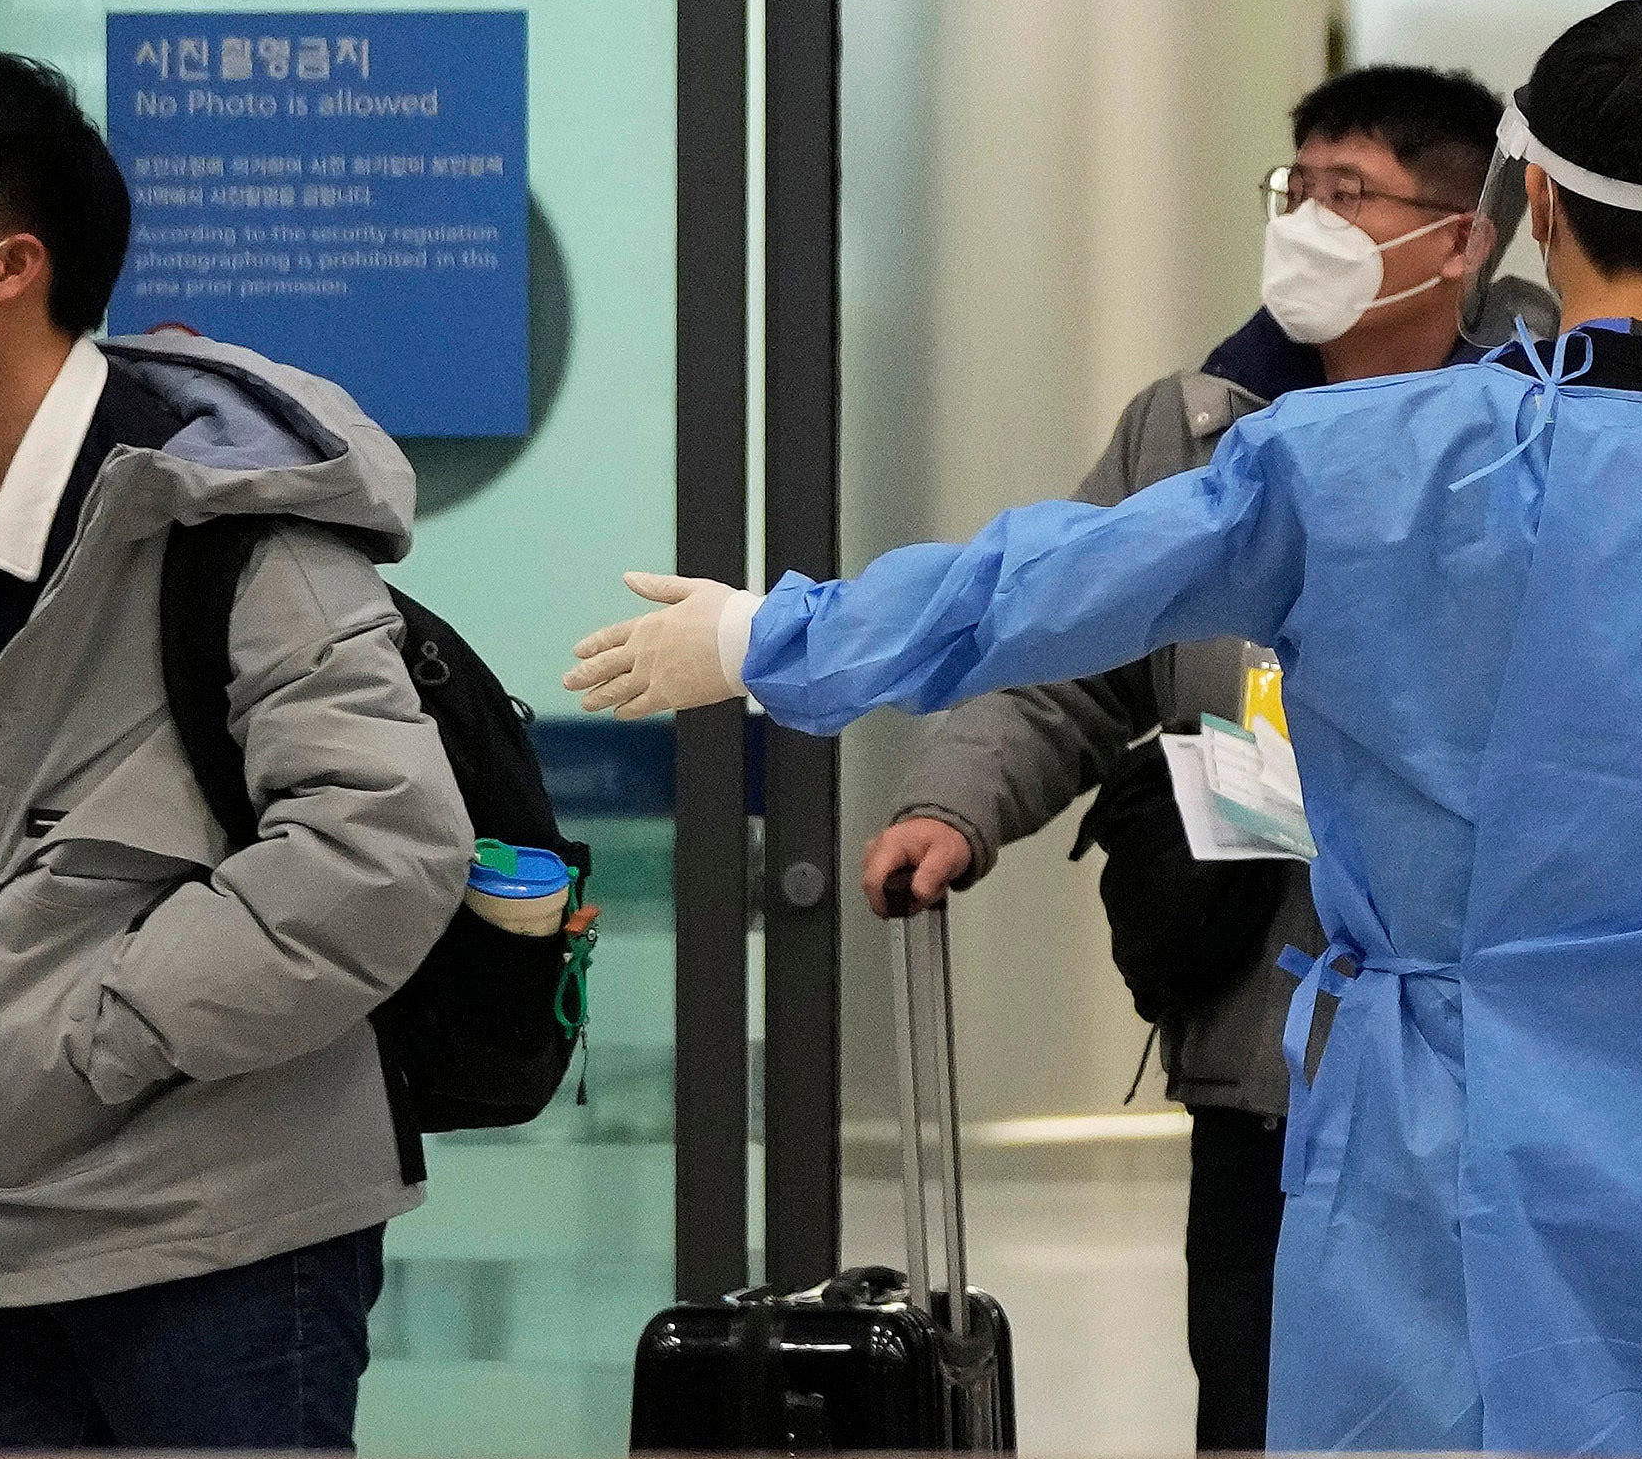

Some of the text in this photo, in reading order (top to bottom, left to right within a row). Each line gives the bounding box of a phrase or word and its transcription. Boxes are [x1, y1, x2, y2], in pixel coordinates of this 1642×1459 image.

[135, 90, 439, 118] No Photo is allowed
[135, 224, 498, 247] According to the security regulation
[134, 250, 291, 273] photographing
[319, 250, 428, 272] prohibited
[435, 250, 455, 269] in
[462, 250, 498, 269] this
[185, 278, 233, 298] prior
